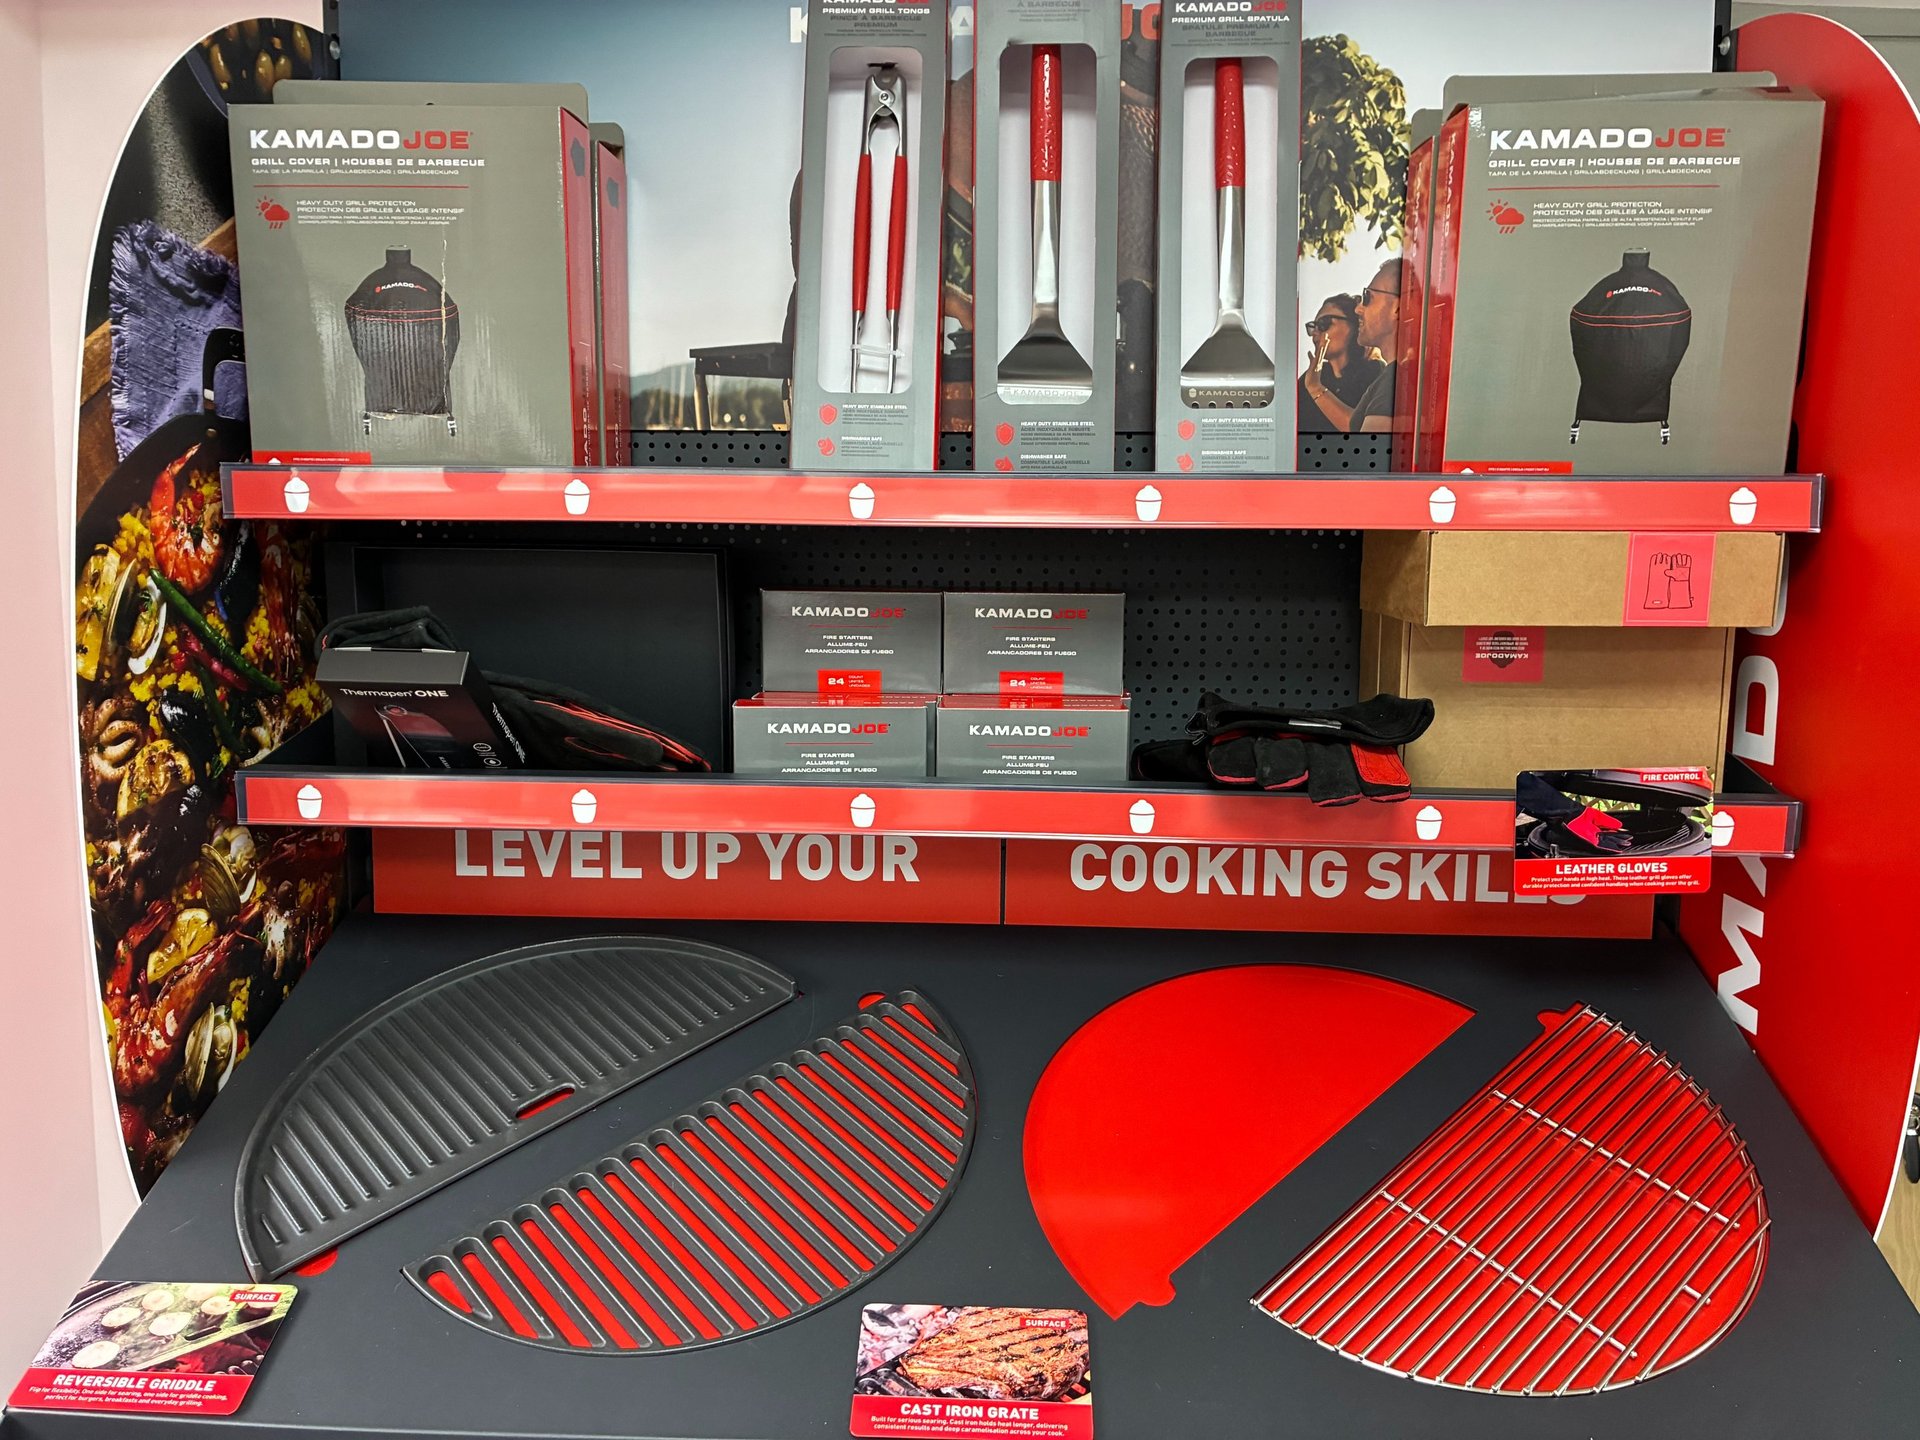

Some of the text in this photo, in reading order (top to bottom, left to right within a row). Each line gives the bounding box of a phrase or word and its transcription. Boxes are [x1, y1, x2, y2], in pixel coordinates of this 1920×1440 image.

[1489, 160, 1525, 168] GRILL
[1531, 158, 1575, 166] COVER
[1588, 158, 1642, 166] HOUSSE
[1669, 157, 1740, 165] BARBECUE
[340, 688, 412, 697] Thermapen
[455, 830, 919, 882] LEVEL UP YOUR
[1071, 843, 1585, 904] COOKING SKIL
[1556, 863, 1667, 874] LEATHER GLOVES
[53, 1374, 216, 1391] REVERSIBLE GRIDDLE
[901, 1403, 1039, 1420] CAST IRON GRATE
[961, 1426, 1009, 1434] caramelisation
[1036, 1422, 1068, 1430] delivering
